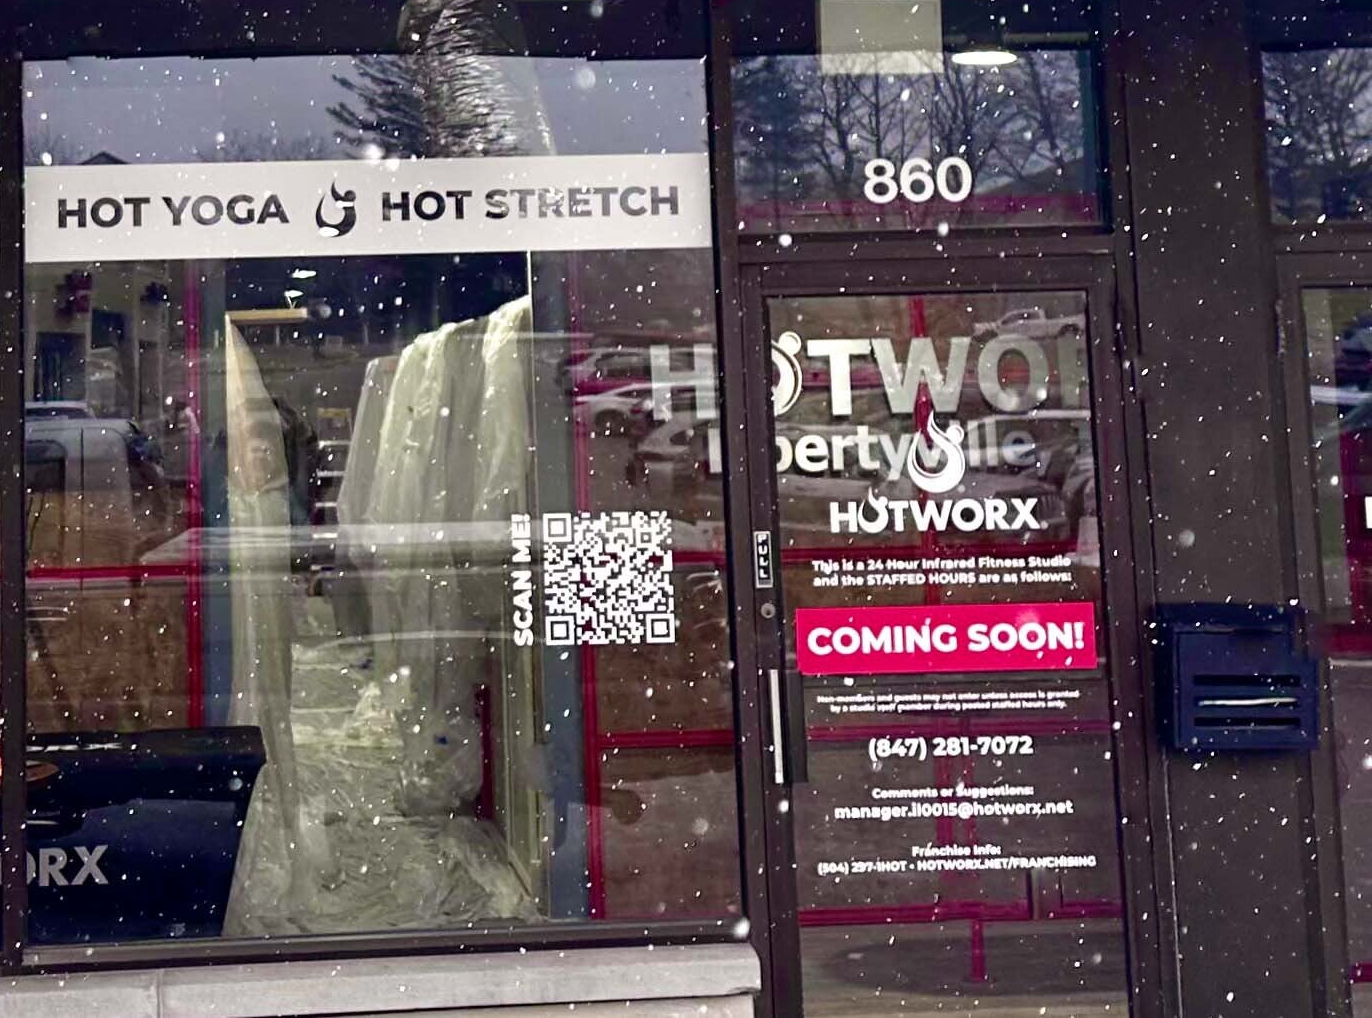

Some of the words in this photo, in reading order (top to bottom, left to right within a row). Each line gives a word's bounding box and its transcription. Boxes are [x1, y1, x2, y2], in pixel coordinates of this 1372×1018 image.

[863, 156, 973, 204] 860
[56, 196, 151, 229] HOT
[161, 193, 290, 227] YOGA
[380, 190, 473, 222] HOT
[484, 185, 681, 219] STRETCH
[829, 487, 1041, 533] HOTWORX
[511, 513, 532, 563] ME!
[757, 533, 769, 579] PULL
[812, 559, 840, 571] This
[842, 559, 853, 571] is
[856, 561, 865, 571] a
[867, 559, 884, 570] 24
[886, 559, 920, 570] Hour
[921, 557, 976, 570] Infrared
[978, 556, 1026, 569] Fitness
[1028, 554, 1072, 567] Studio
[813, 573, 839, 587] and
[841, 573, 864, 586] the
[867, 573, 926, 585] STAFFED
[928, 572, 976, 584] HOURS
[978, 572, 1000, 583] are
[1003, 572, 1018, 583] as
[1020, 570, 1072, 582] follows:
[511, 570, 534, 646] SCAN
[807, 624, 958, 655] COMING
[967, 621, 1085, 652] SOON!
[868, 737, 928, 761] (847)
[932, 735, 1034, 757] 281-7072
[871, 787, 939, 799] Comments
[940, 788, 954, 798] or
[955, 784, 1034, 798] Suggestions:
[911, 844, 971, 857] Franchise
[973, 844, 1002, 856] Info:
[817, 861, 850, 875] (504)
